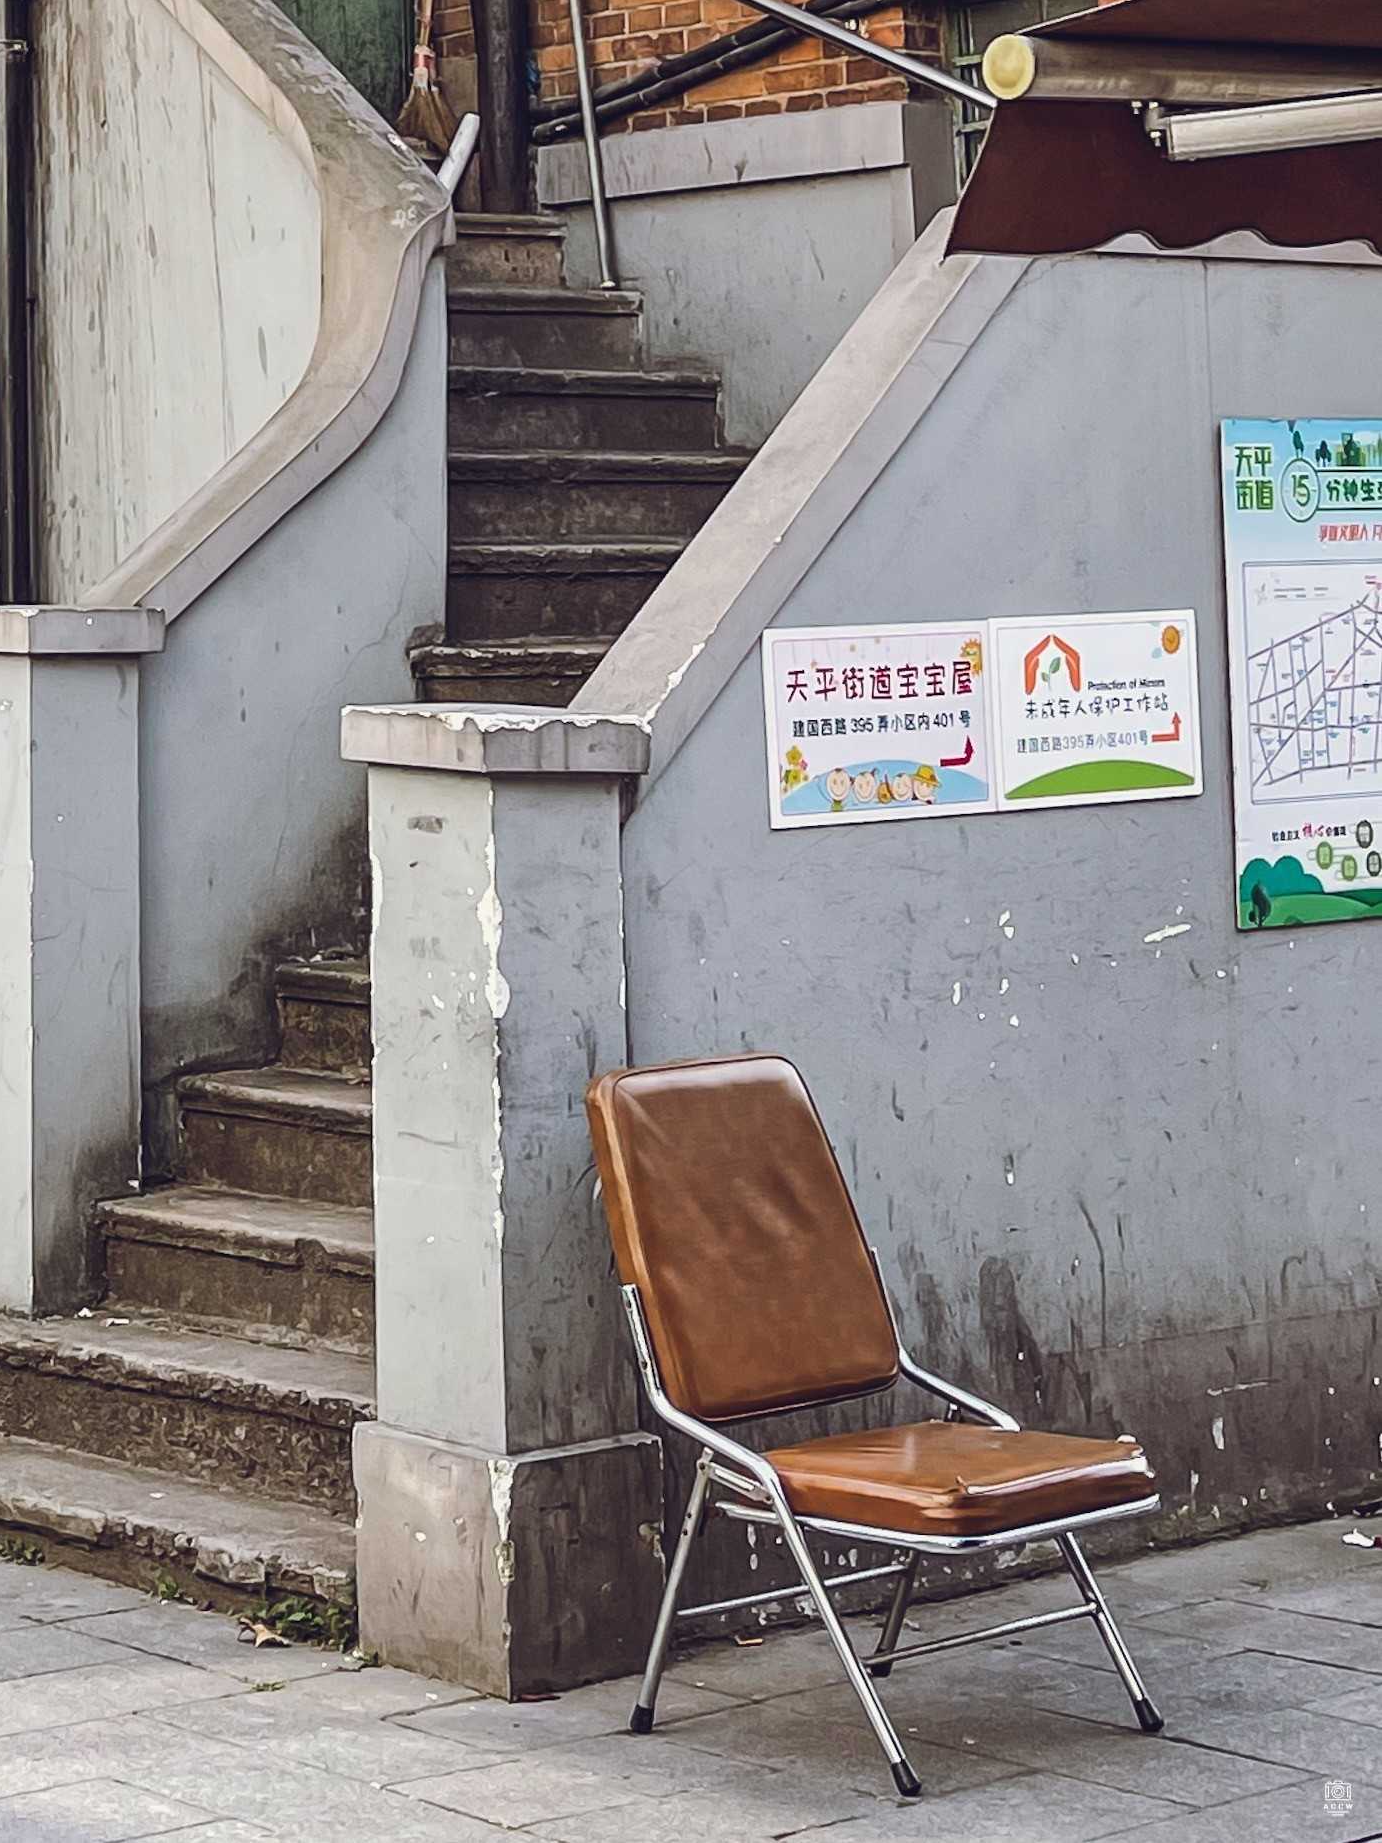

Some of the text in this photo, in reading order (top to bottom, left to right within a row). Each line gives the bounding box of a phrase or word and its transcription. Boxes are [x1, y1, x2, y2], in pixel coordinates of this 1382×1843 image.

[1234, 445, 1273, 477] 天平
[1235, 479, 1274, 511] 街道
[1290, 474, 1311, 507] 15
[786, 660, 973, 703] 天平街道宝宝屋
[1025, 693, 1169, 719] 未成年人保护工作站
